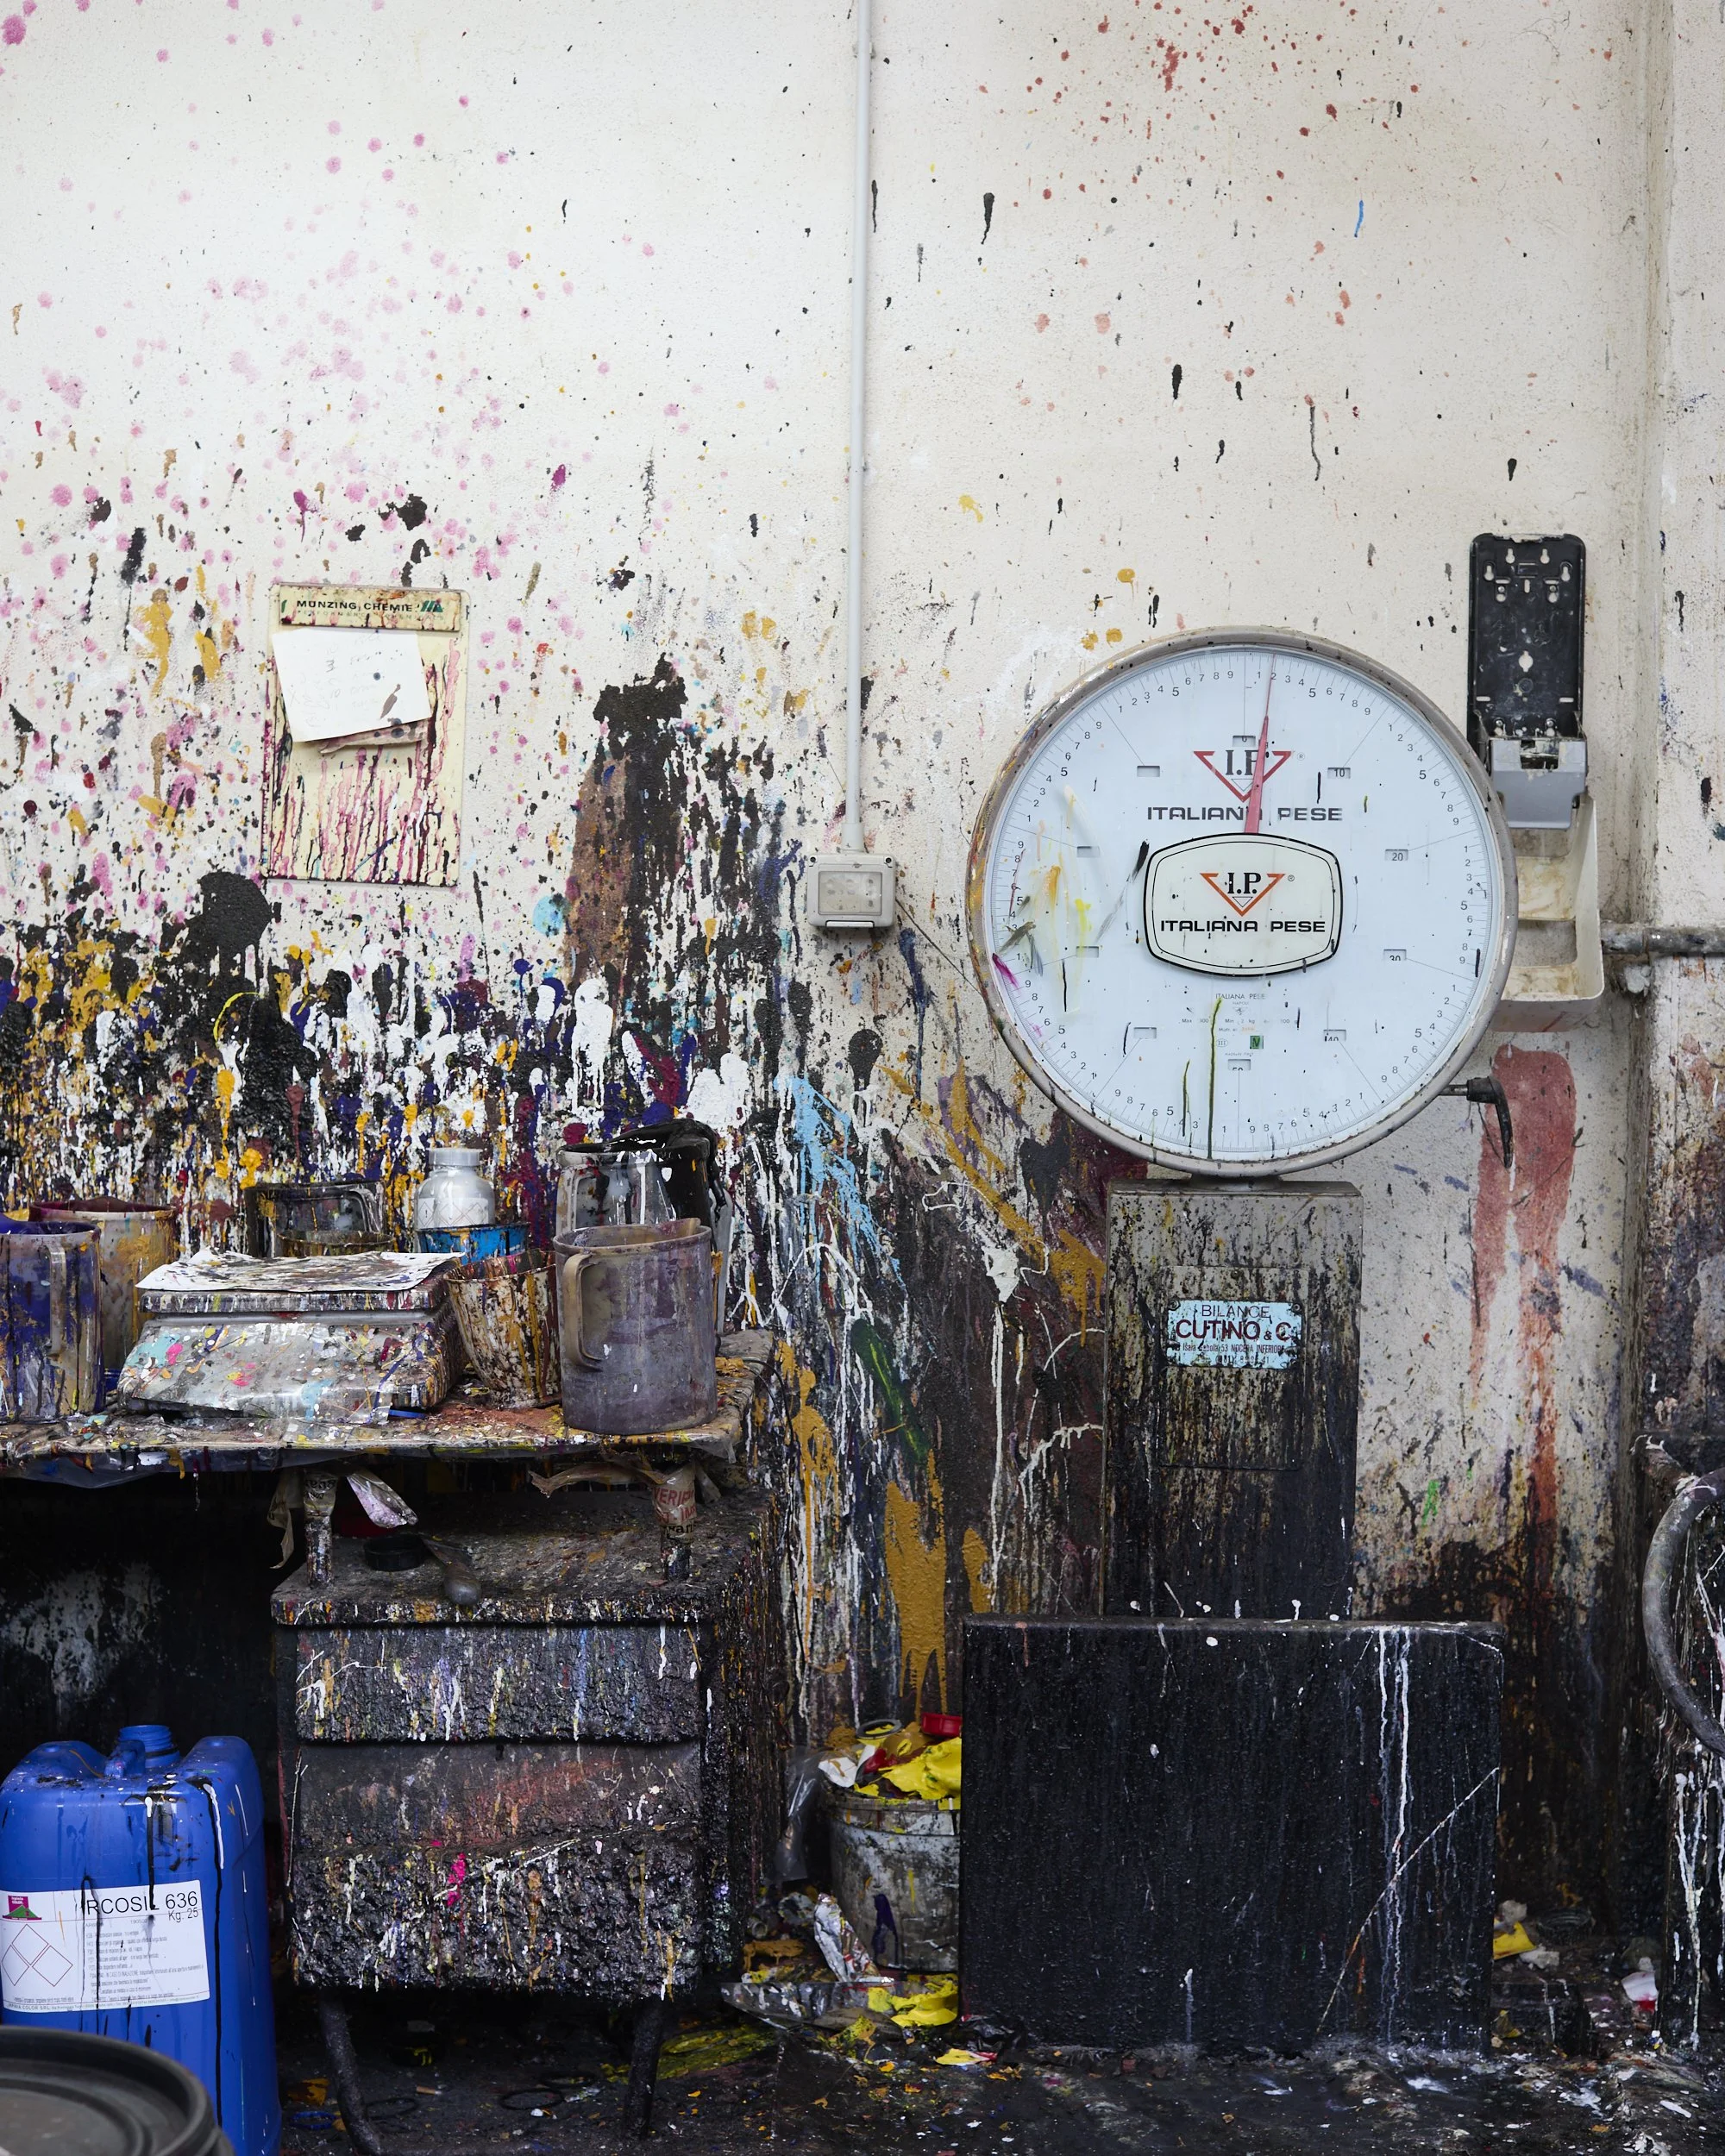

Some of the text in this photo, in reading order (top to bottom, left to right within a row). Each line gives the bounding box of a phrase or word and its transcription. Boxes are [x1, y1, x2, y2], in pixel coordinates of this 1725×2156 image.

[364, 603, 412, 611] CHEMIE
[1172, 687, 1179, 696] 5
[1309, 688, 1315, 698] 5
[1061, 768, 1068, 776] 5
[1065, 752, 1070, 761] 6
[1334, 768, 1345, 777] 10
[1420, 770, 1426, 780] 5
[1278, 807, 1343, 820] PESE
[1392, 852, 1403, 862] 20
[1013, 867, 1018, 876] 7
[1017, 896, 1024, 906] 5
[1227, 873, 1261, 894] I.P.
[1461, 900, 1467, 910] 5
[1161, 920, 1325, 932] ITALIANA PESE
[1058, 1025, 1065, 1034] 5
[1415, 1029, 1421, 1037] 5
[1167, 1106, 1173, 1115] 5
[1202, 1305, 1270, 1319] BILANCE
[1176, 1319, 1260, 1339] CUTINO
[1264, 1331, 1272, 1340] &
[166, 1891, 198, 1909] 636
[168, 1907, 198, 1922] Kg. 25
